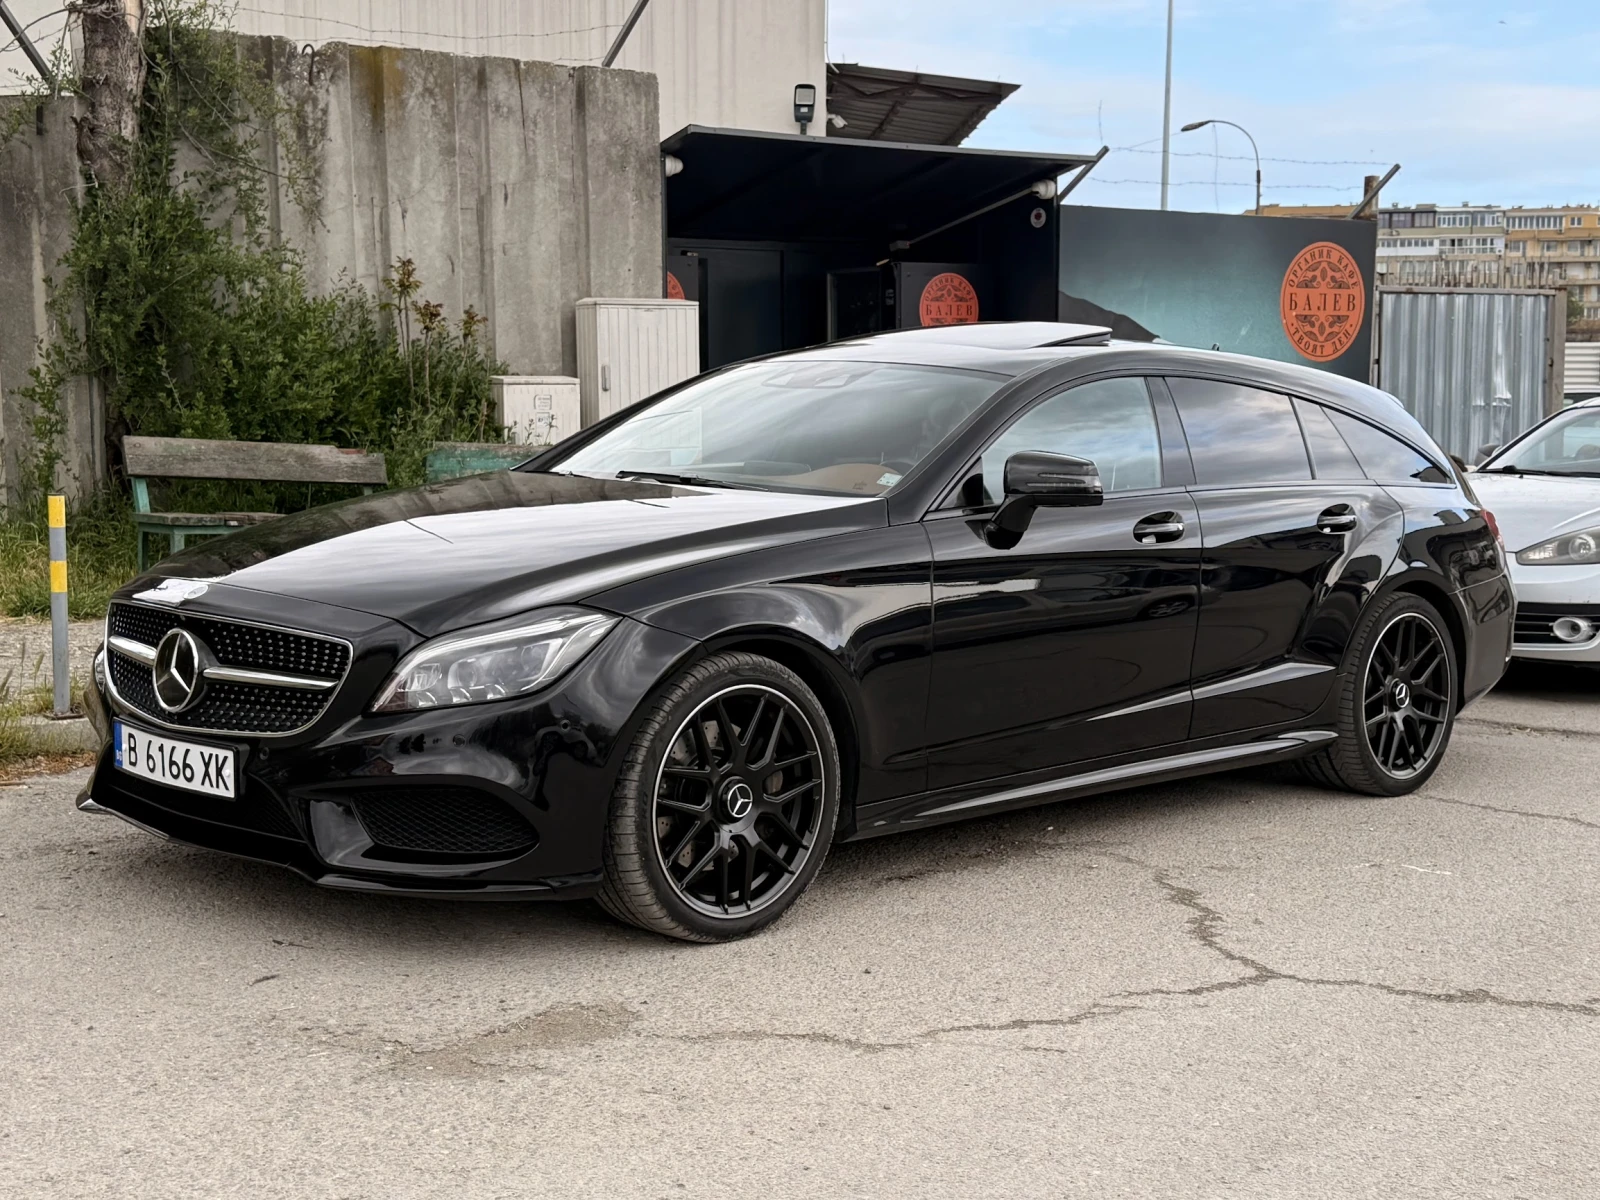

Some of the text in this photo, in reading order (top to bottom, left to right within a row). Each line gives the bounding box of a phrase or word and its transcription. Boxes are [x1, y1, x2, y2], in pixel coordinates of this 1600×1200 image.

[1288, 248, 1359, 290] ОРГАНИК КАФЕ
[926, 304, 973, 316] БАЛЕВ
[1289, 292, 1356, 312] БАЛЕВ
[1291, 327, 1351, 355] ТВОЯТ ДЕН
[128, 732, 230, 791] B 6166 XK
